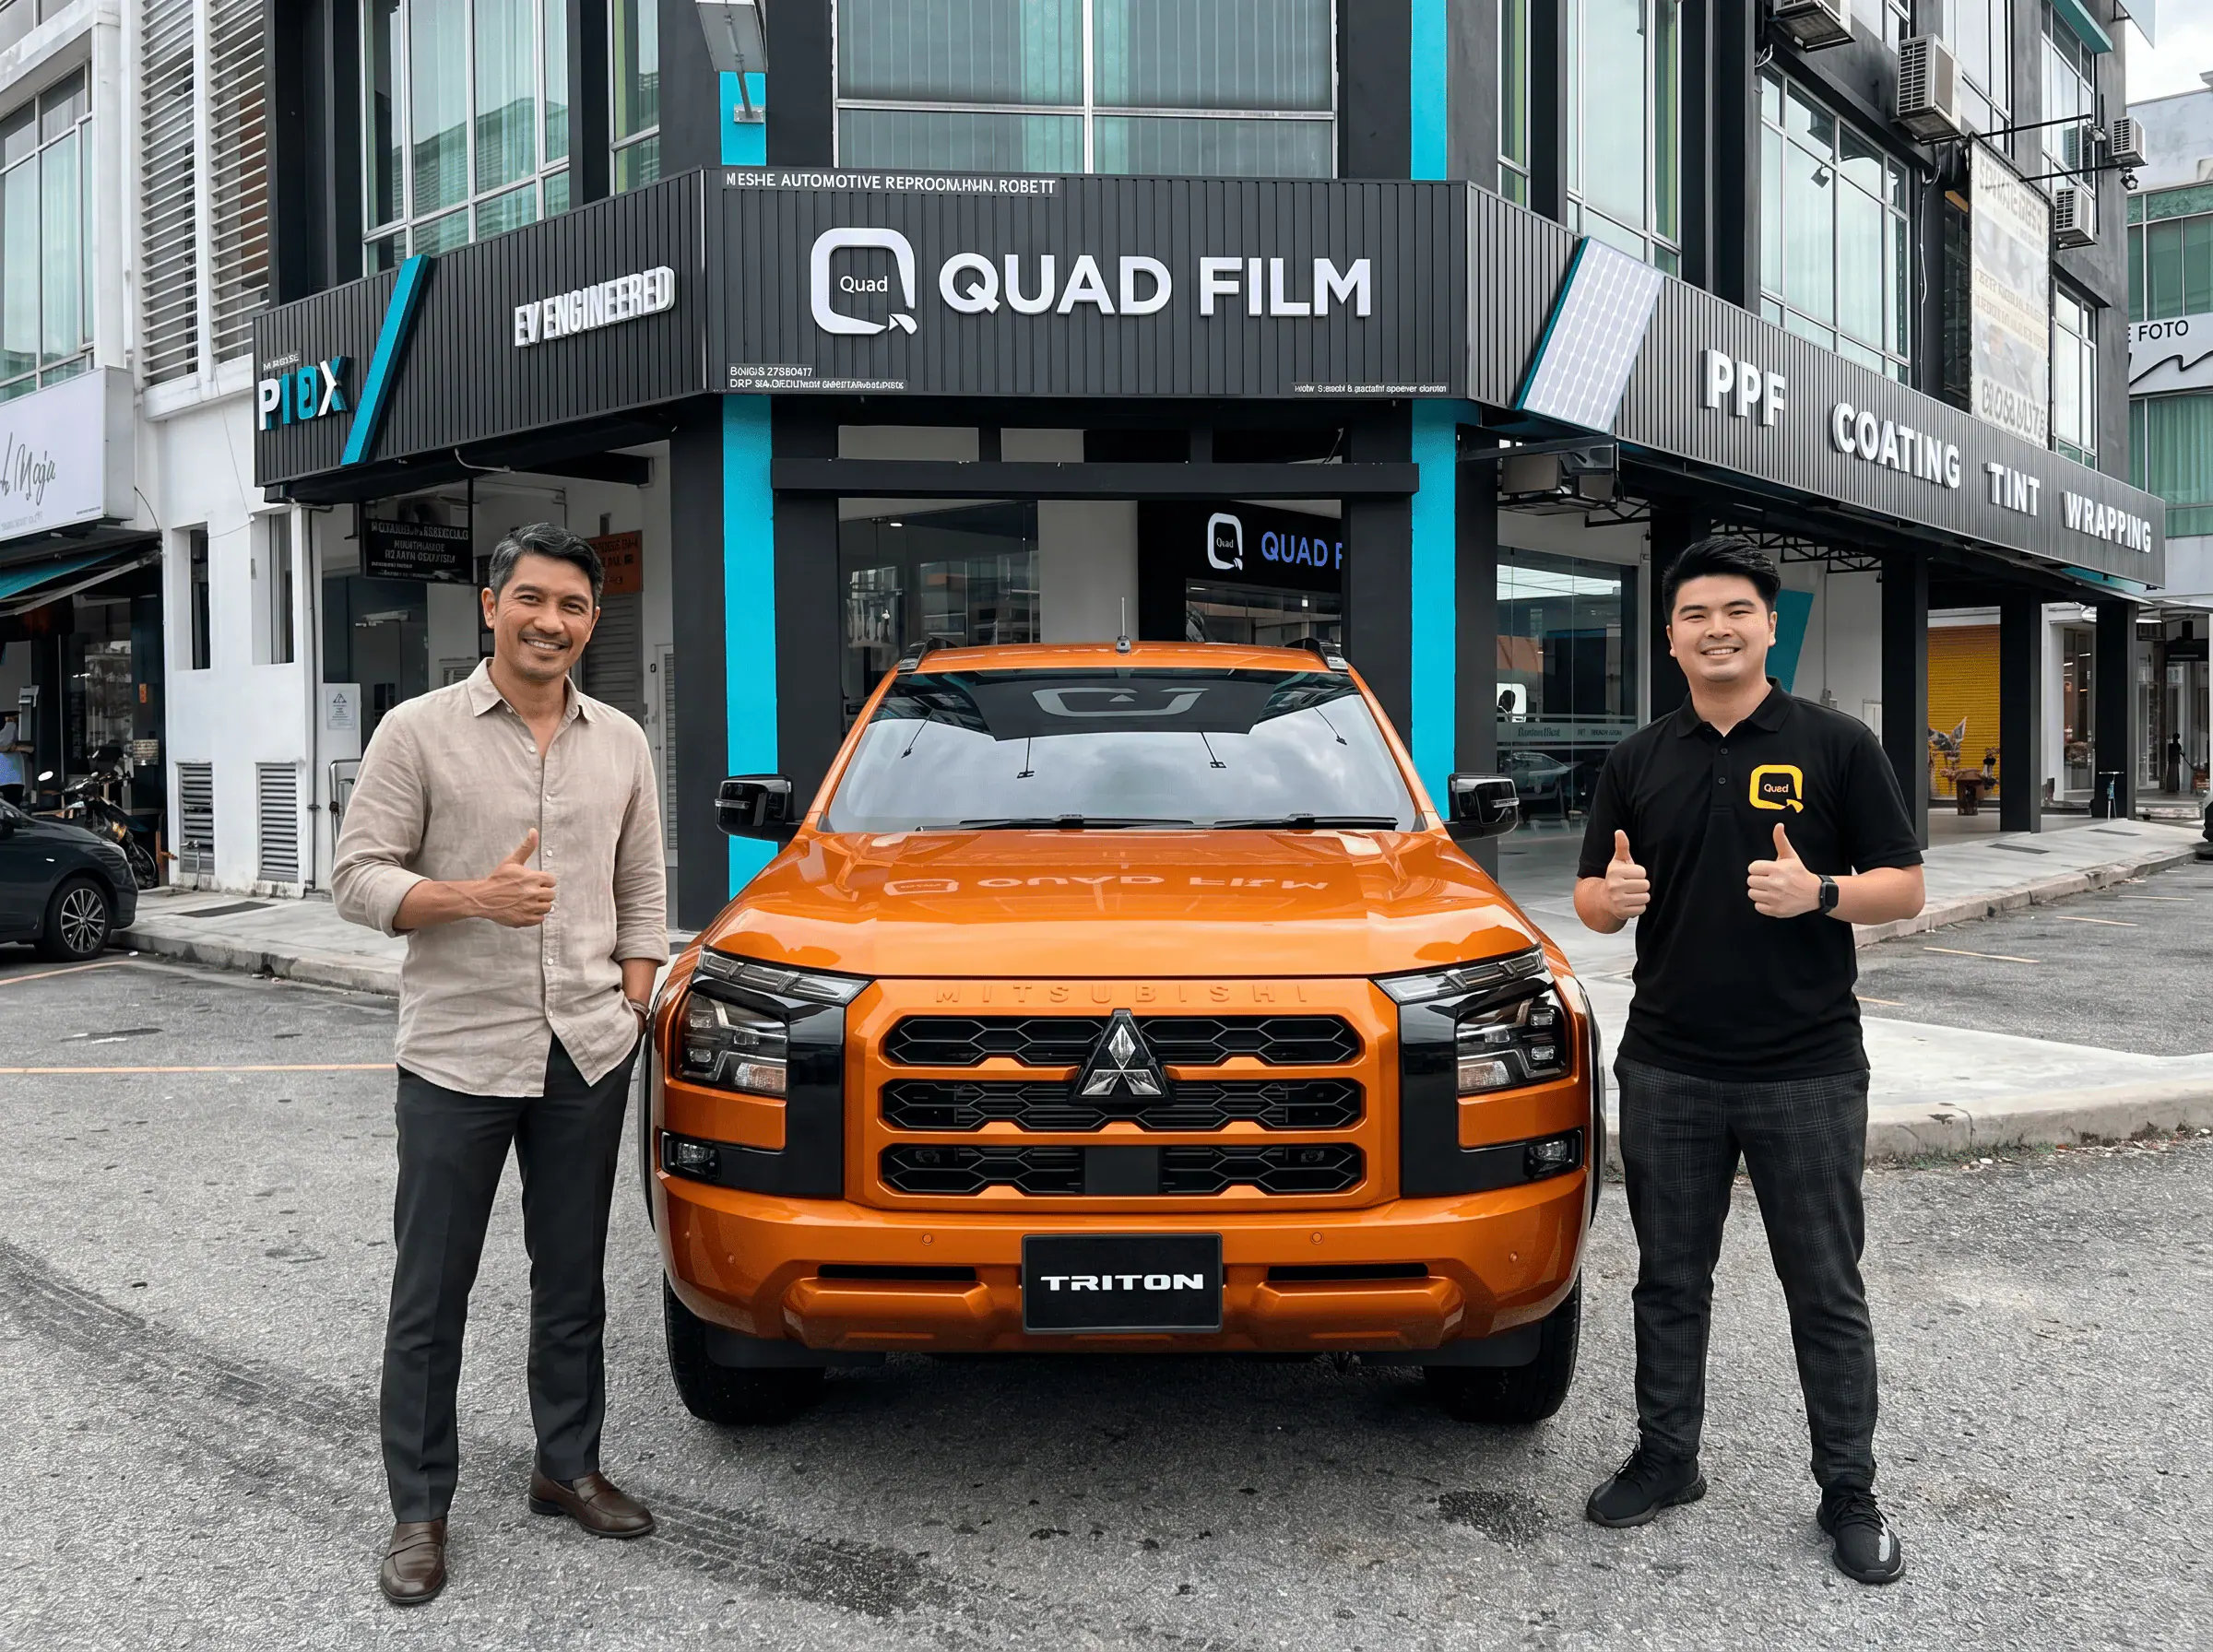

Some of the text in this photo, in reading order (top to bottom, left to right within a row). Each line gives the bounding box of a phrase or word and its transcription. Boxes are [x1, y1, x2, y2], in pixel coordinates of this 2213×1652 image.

[781, 173, 882, 189] AUTOMOTIVE
[999, 180, 1056, 194] ROBETT
[839, 276, 888, 293] Quad
[939, 253, 1371, 317] QUAD FILM
[542, 266, 676, 341] ENGINEERED
[2138, 320, 2189, 342] FOTO
[1704, 348, 1786, 428] PPF
[1832, 402, 1960, 490] COATING
[1983, 462, 2041, 516] TINT
[2063, 490, 2152, 553] WRAPPING
[1260, 531, 1329, 567] QUAD
[936, 984, 1308, 1004] MITSUBISHI
[1040, 1273, 1204, 1292] TRITON
